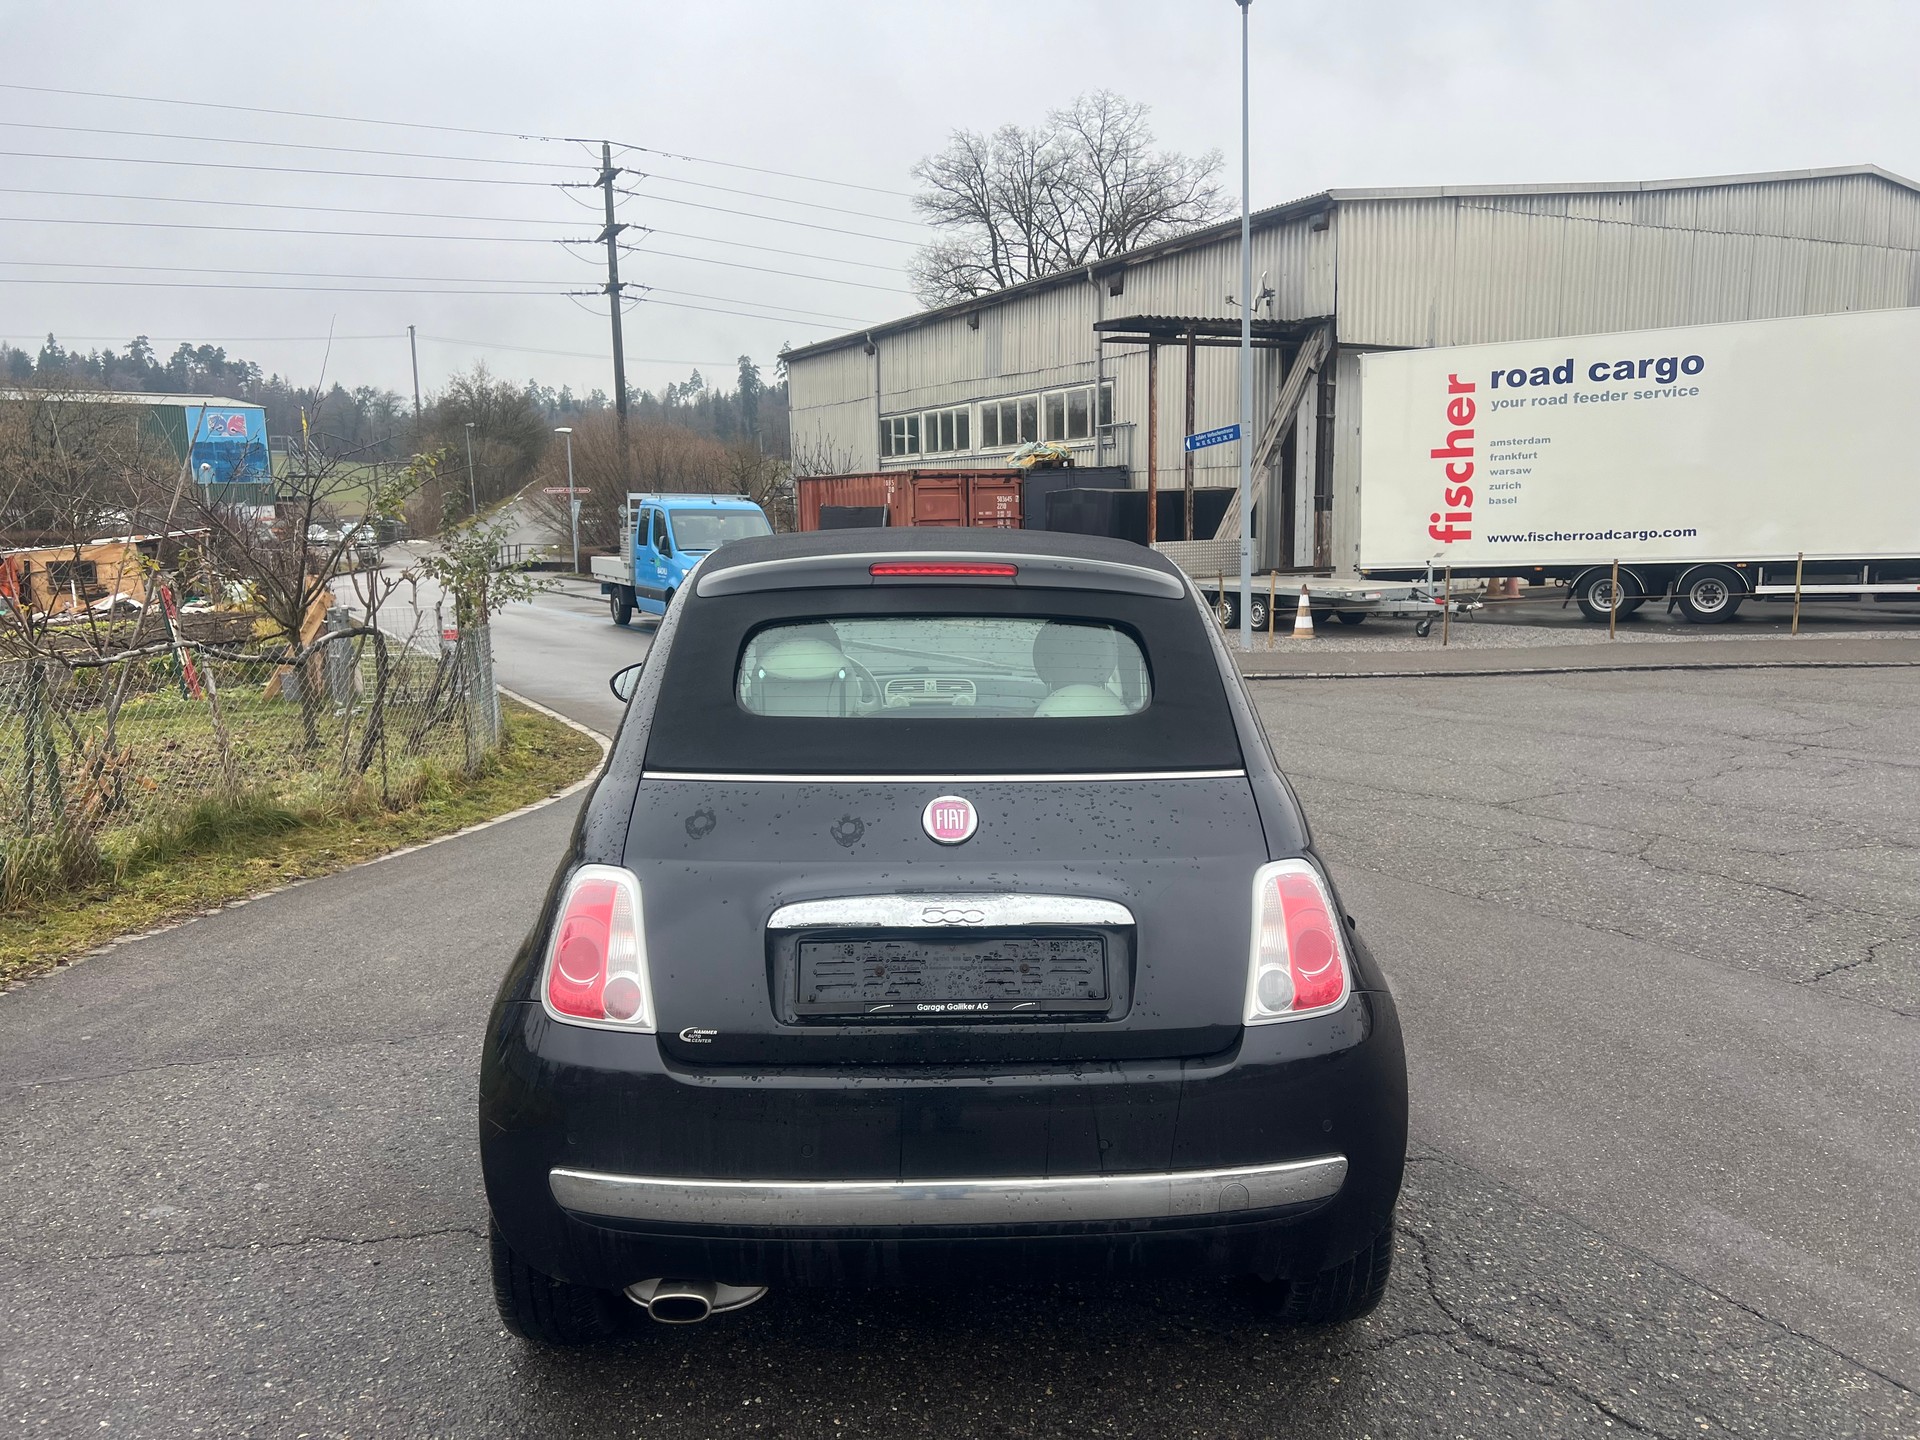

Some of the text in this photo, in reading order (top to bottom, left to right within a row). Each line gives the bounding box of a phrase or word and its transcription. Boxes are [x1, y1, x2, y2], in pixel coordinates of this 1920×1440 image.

[1491, 354, 1705, 389] road cargo
[1491, 385, 1700, 412] your road feeder service
[1489, 436, 1551, 447] amsterdam
[1428, 373, 1476, 544] fischer
[1489, 451, 1538, 461] frankfurt
[1489, 467, 1532, 476] warsaw
[1488, 481, 1522, 491] zurich
[1488, 496, 1517, 505] basel
[1487, 527, 1697, 543] www.fischerroadcargo.com
[935, 808, 966, 830] FIAT
[921, 906, 985, 924] 500
[916, 1003, 946, 1012] Garage
[976, 1002, 989, 1010] AG
